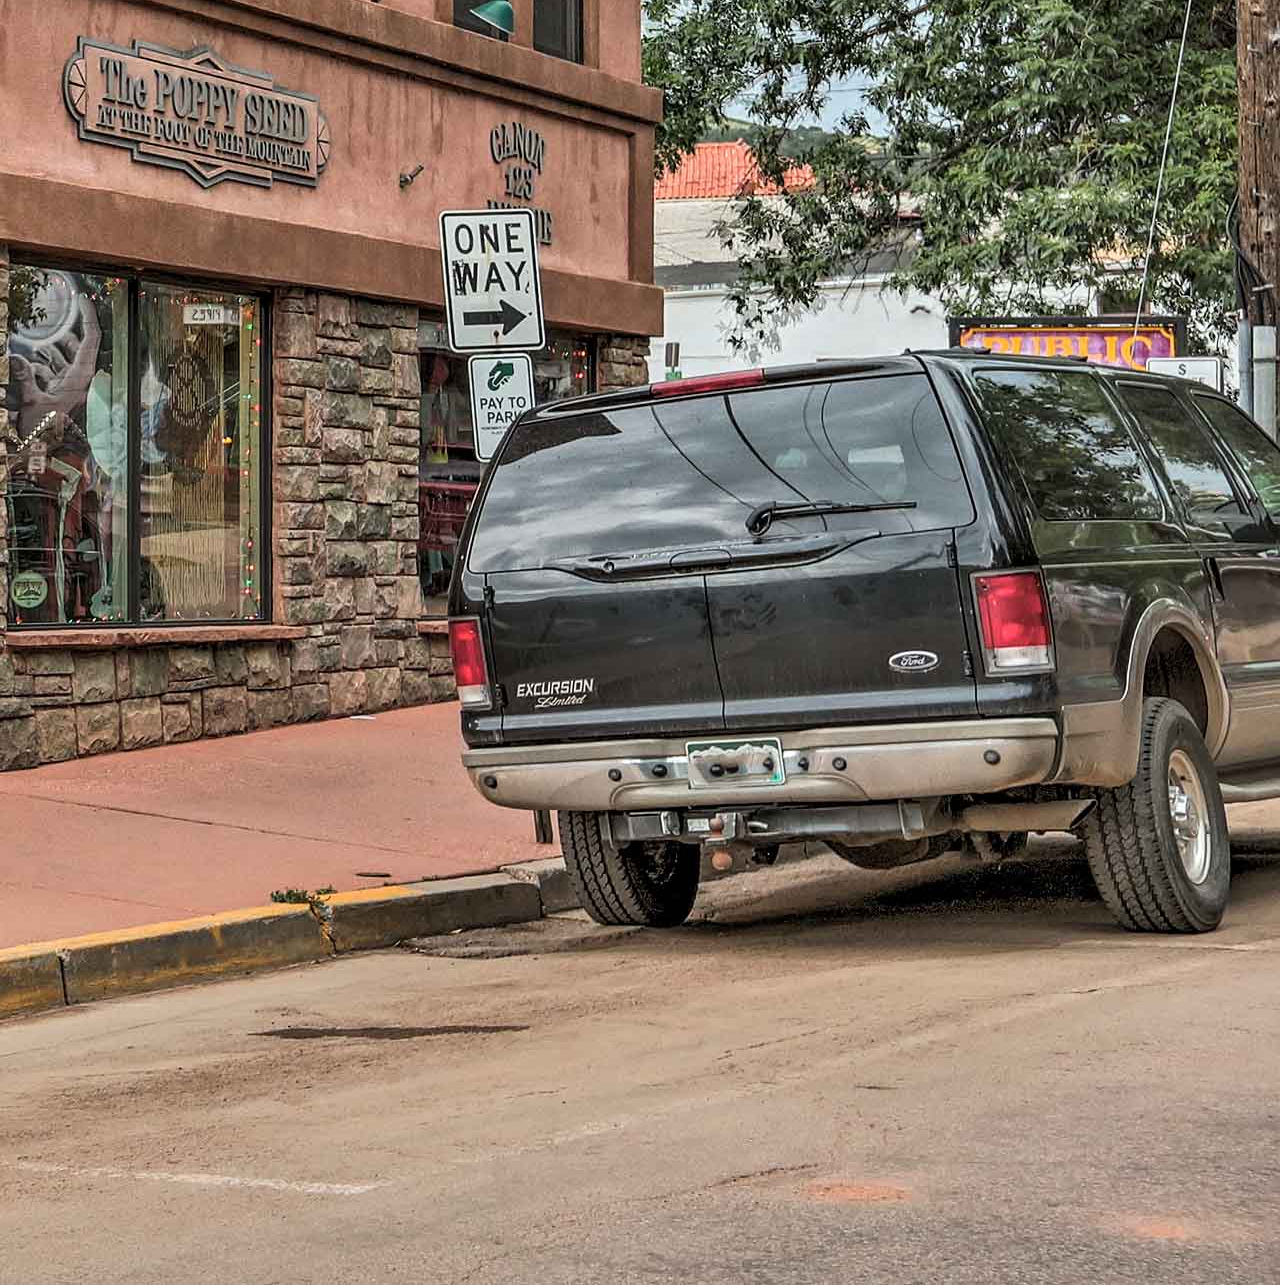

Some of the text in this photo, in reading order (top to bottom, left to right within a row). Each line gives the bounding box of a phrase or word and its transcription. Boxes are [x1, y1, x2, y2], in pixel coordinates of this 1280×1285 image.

[100, 57, 310, 144] The POPPY SEED
[96, 104, 310, 171] AT THE FOOT OF THE MOUNTAIN
[490, 122, 544, 175] CANON
[505, 166, 533, 201] 123
[454, 223, 524, 254] ONE
[452, 260, 526, 295] WAY
[983, 335, 1153, 372] PUBLIC
[480, 396, 527, 410] PAY TO
[900, 655, 926, 667] Ford
[516, 678, 594, 698] EXCURSION
[534, 694, 588, 709] Limited
